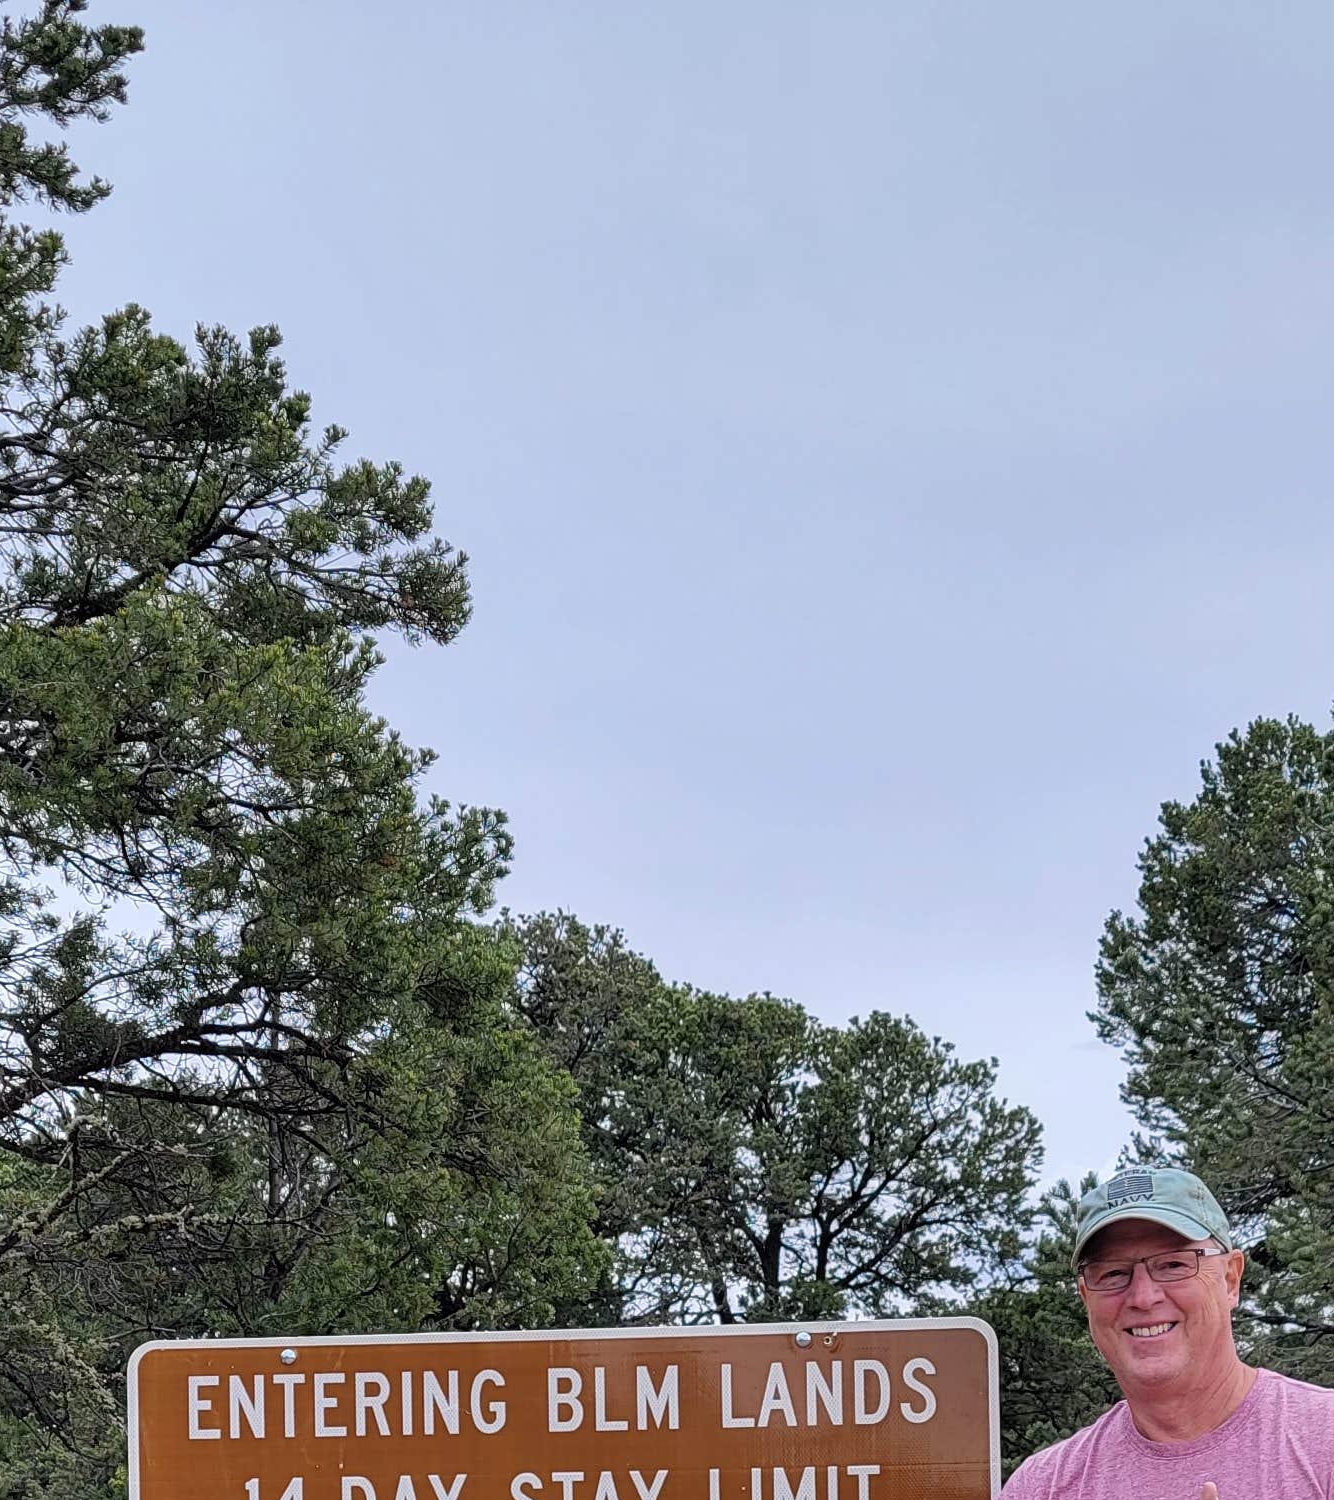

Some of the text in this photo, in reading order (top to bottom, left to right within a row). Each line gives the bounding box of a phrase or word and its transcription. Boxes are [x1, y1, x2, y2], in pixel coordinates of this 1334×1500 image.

[1107, 1193, 1154, 1209] NAVY
[187, 1357, 938, 1440] ENTERING BLM LANDS
